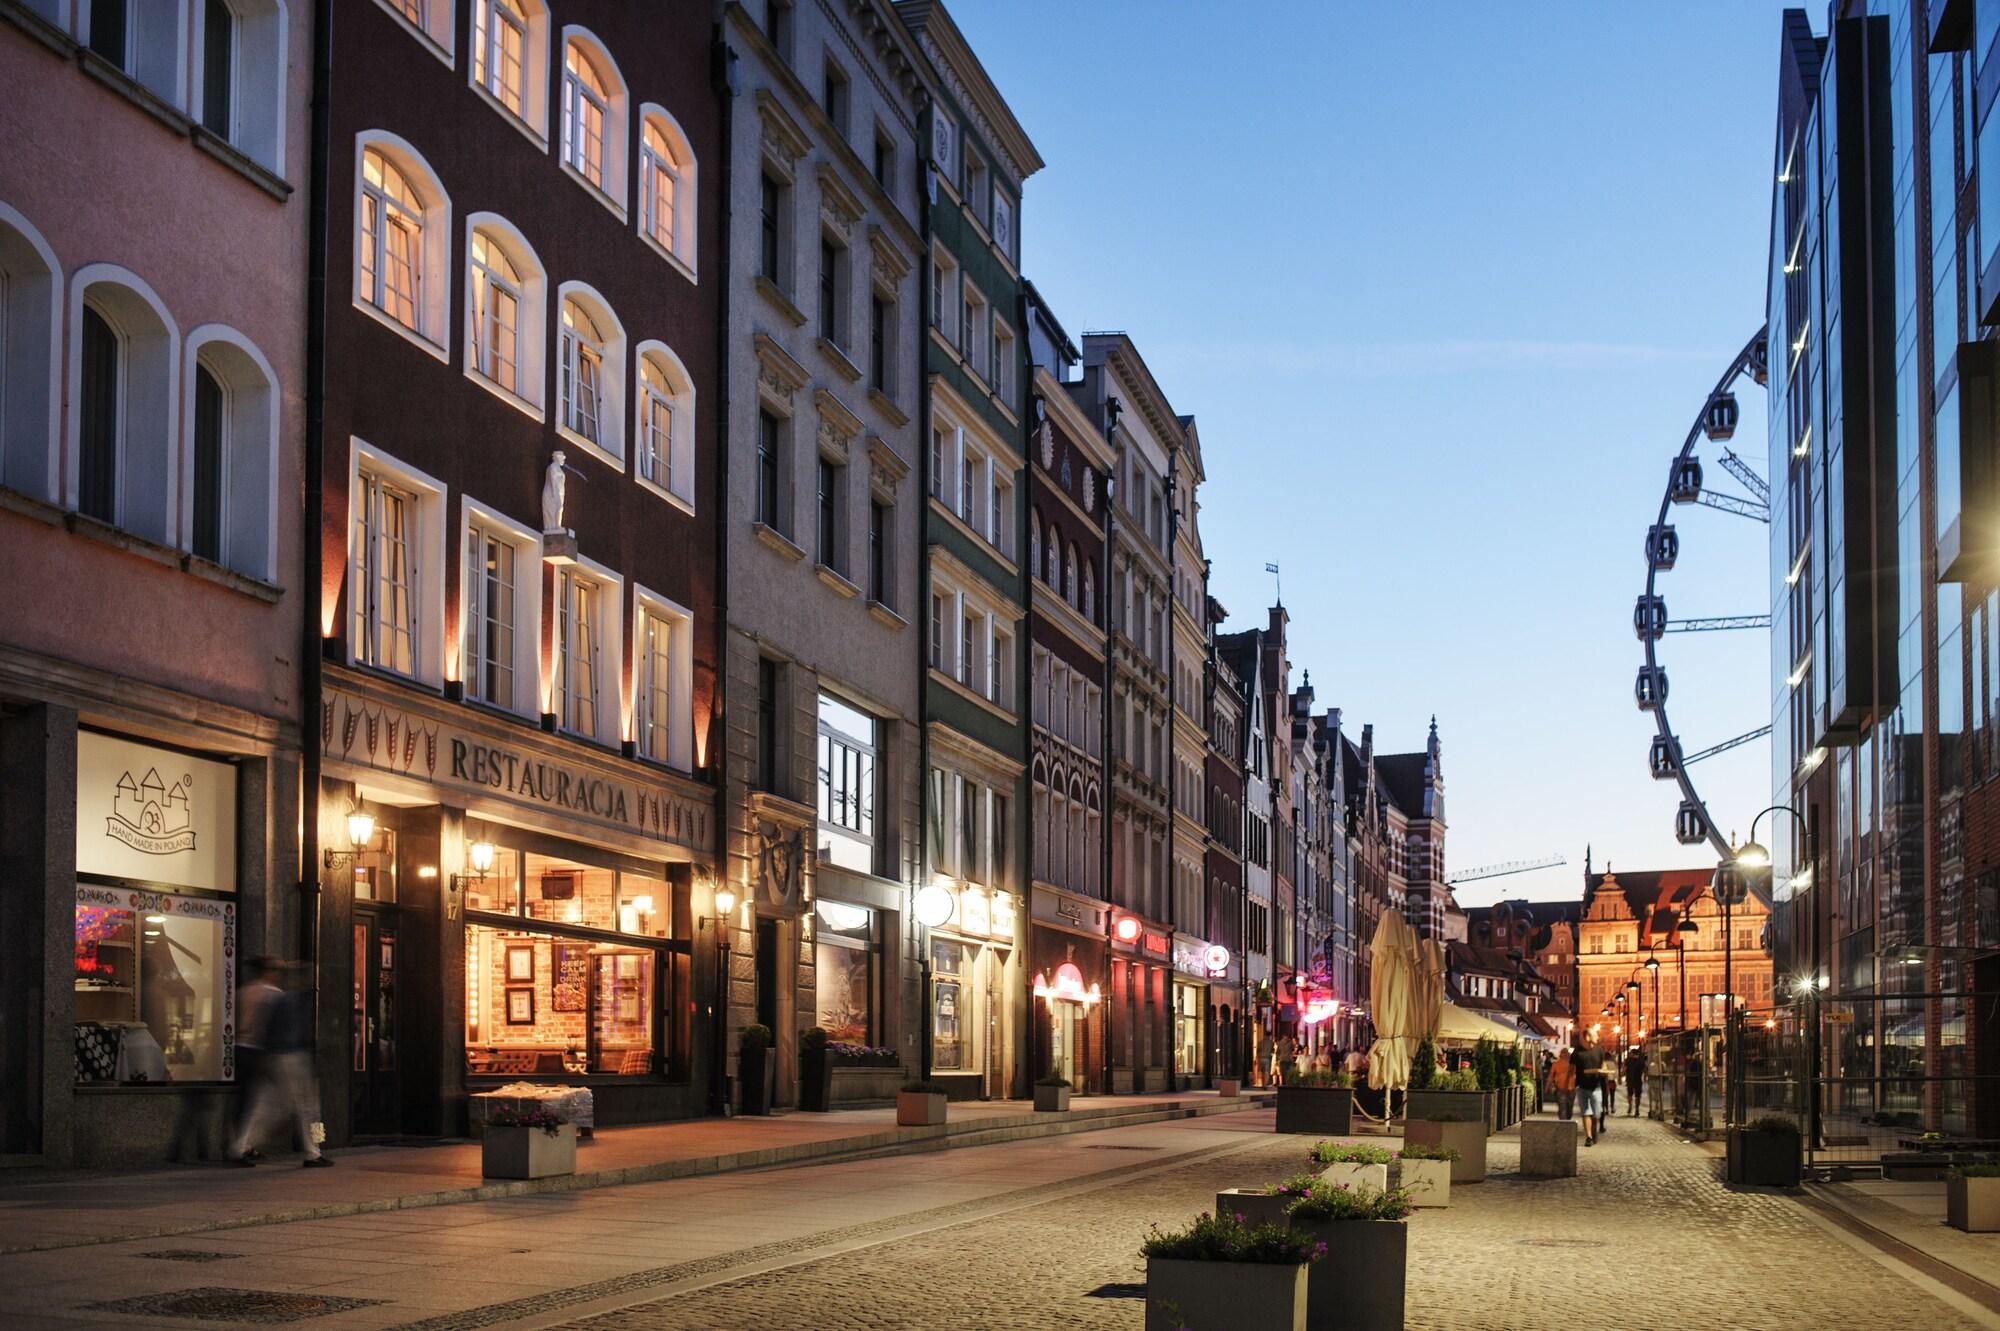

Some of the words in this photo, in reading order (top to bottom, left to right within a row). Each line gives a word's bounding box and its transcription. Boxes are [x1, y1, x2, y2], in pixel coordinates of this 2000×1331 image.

[451, 737, 628, 822] RESTAURACJA
[112, 824, 133, 843] HAND
[134, 838, 153, 851] MADE
[154, 842, 162, 850] IN
[163, 837, 191, 850] POLAND
[447, 902, 458, 920] 17
[561, 960, 586, 968] KEEP
[560, 976, 587, 984] DRINK
